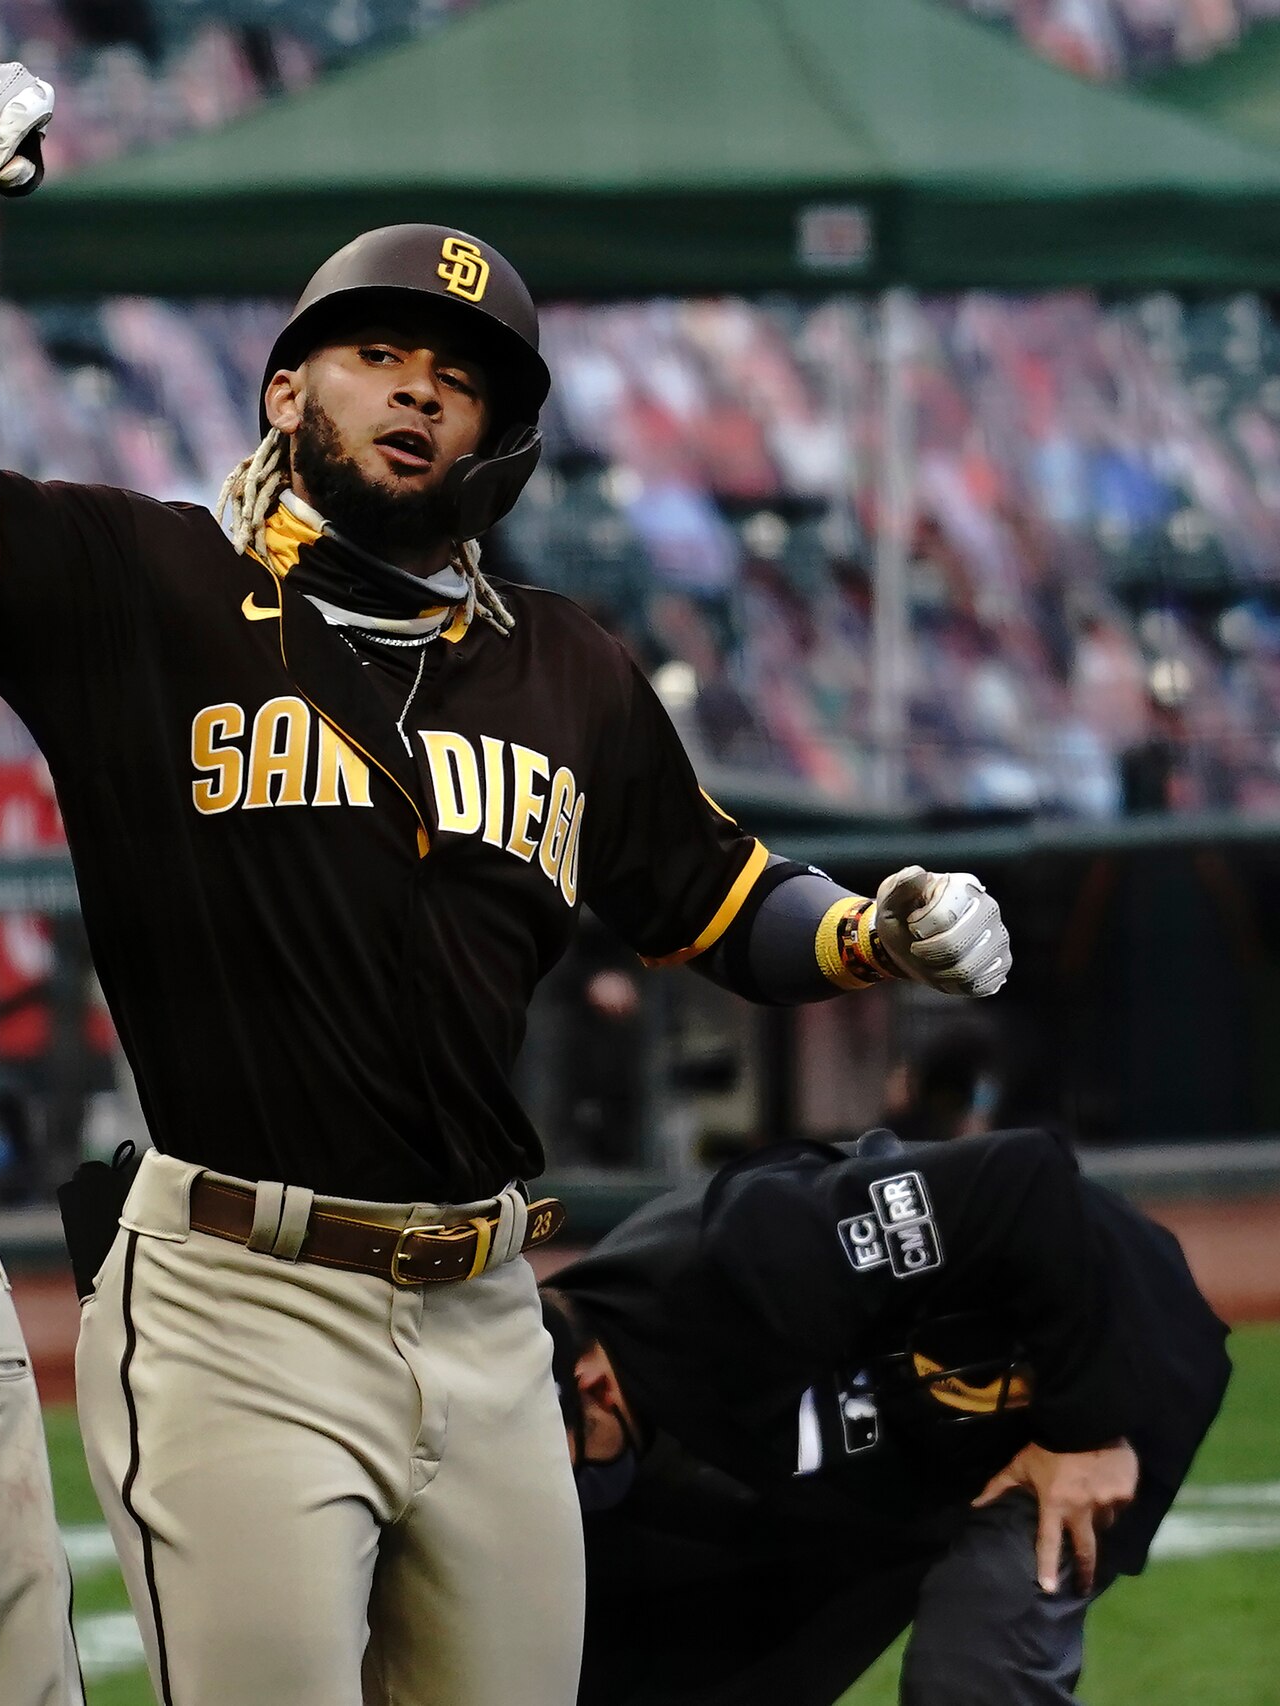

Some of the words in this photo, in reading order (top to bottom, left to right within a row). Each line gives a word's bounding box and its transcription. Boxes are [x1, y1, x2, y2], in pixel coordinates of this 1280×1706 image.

[437, 237, 490, 303] SD
[191, 695, 375, 816] SAN
[417, 729, 585, 908] DIEGO
[883, 1180, 917, 1221] RR
[531, 1210, 553, 1240] 23
[850, 1219, 882, 1265] EC
[897, 1226, 927, 1269] CM
